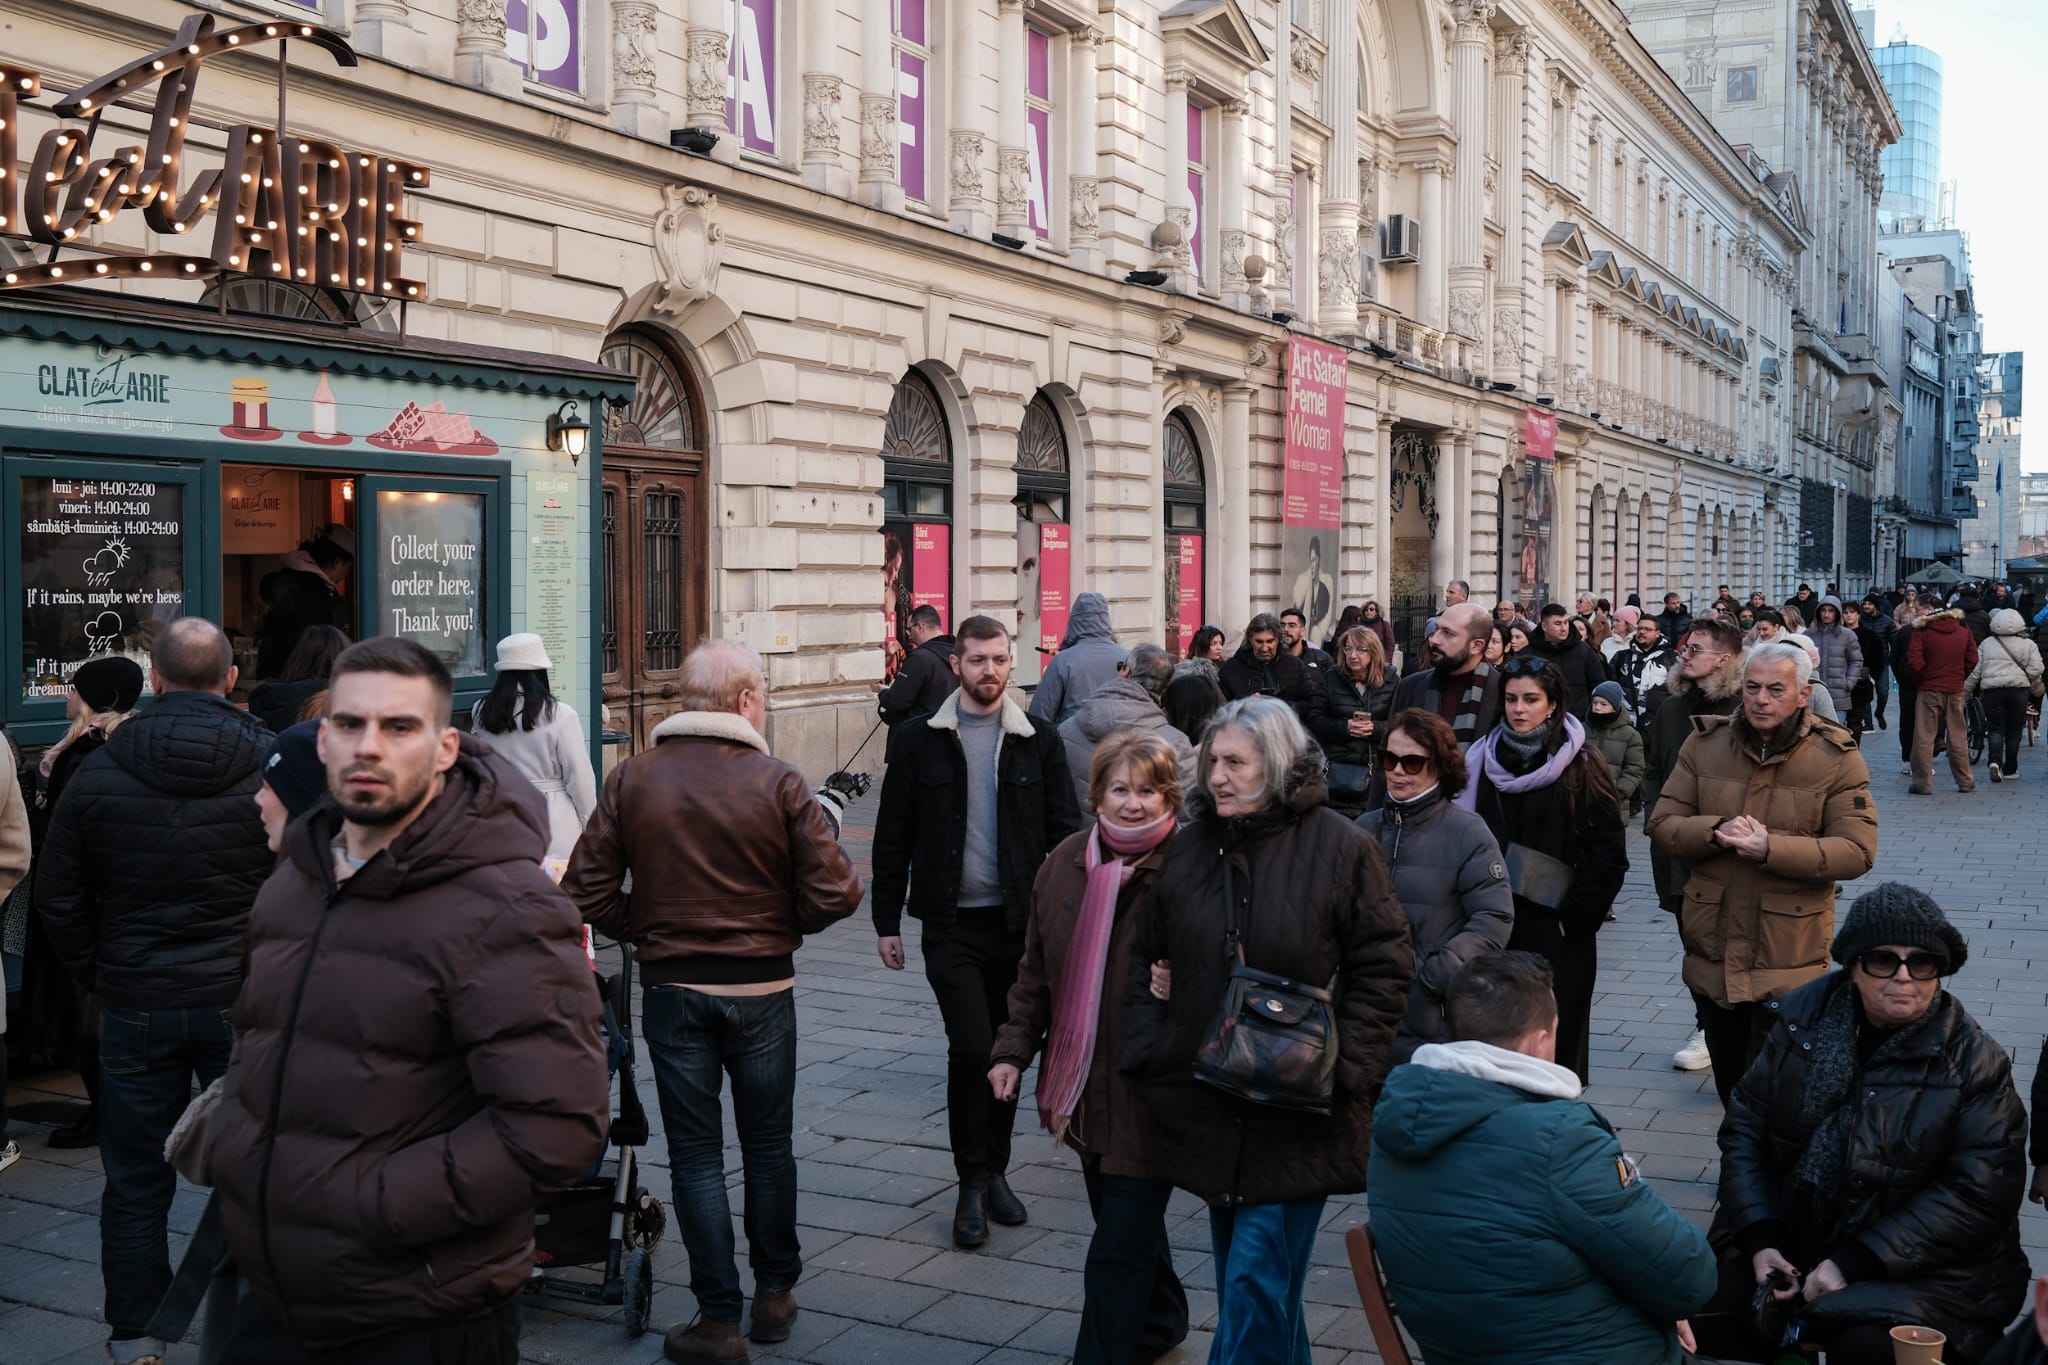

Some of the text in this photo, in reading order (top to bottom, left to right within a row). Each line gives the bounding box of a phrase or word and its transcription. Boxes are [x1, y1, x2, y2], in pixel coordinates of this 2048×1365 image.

[1291, 343, 1346, 389] Art Safari
[1290, 377, 1328, 417] Femei
[107, 410, 119, 426] de
[1289, 411, 1331, 452] Women
[52, 478, 72, 494] luni
[80, 480, 98, 498] joi:
[100, 481, 156, 497] 14:00-22:00
[58, 500, 150, 516] vineri: 14:00-24:00
[124, 521, 179, 536] 14:00-24:00
[391, 534, 476, 567] Collect your
[391, 571, 475, 597] order here.
[27, 588, 38, 608] If
[40, 589, 50, 606] it
[52, 589, 85, 606] rains,
[88, 588, 123, 608] maybe
[156, 588, 182, 604] here.
[392, 606, 474, 638] Thank you!
[35, 658, 46, 677] If
[49, 658, 59, 675] it
